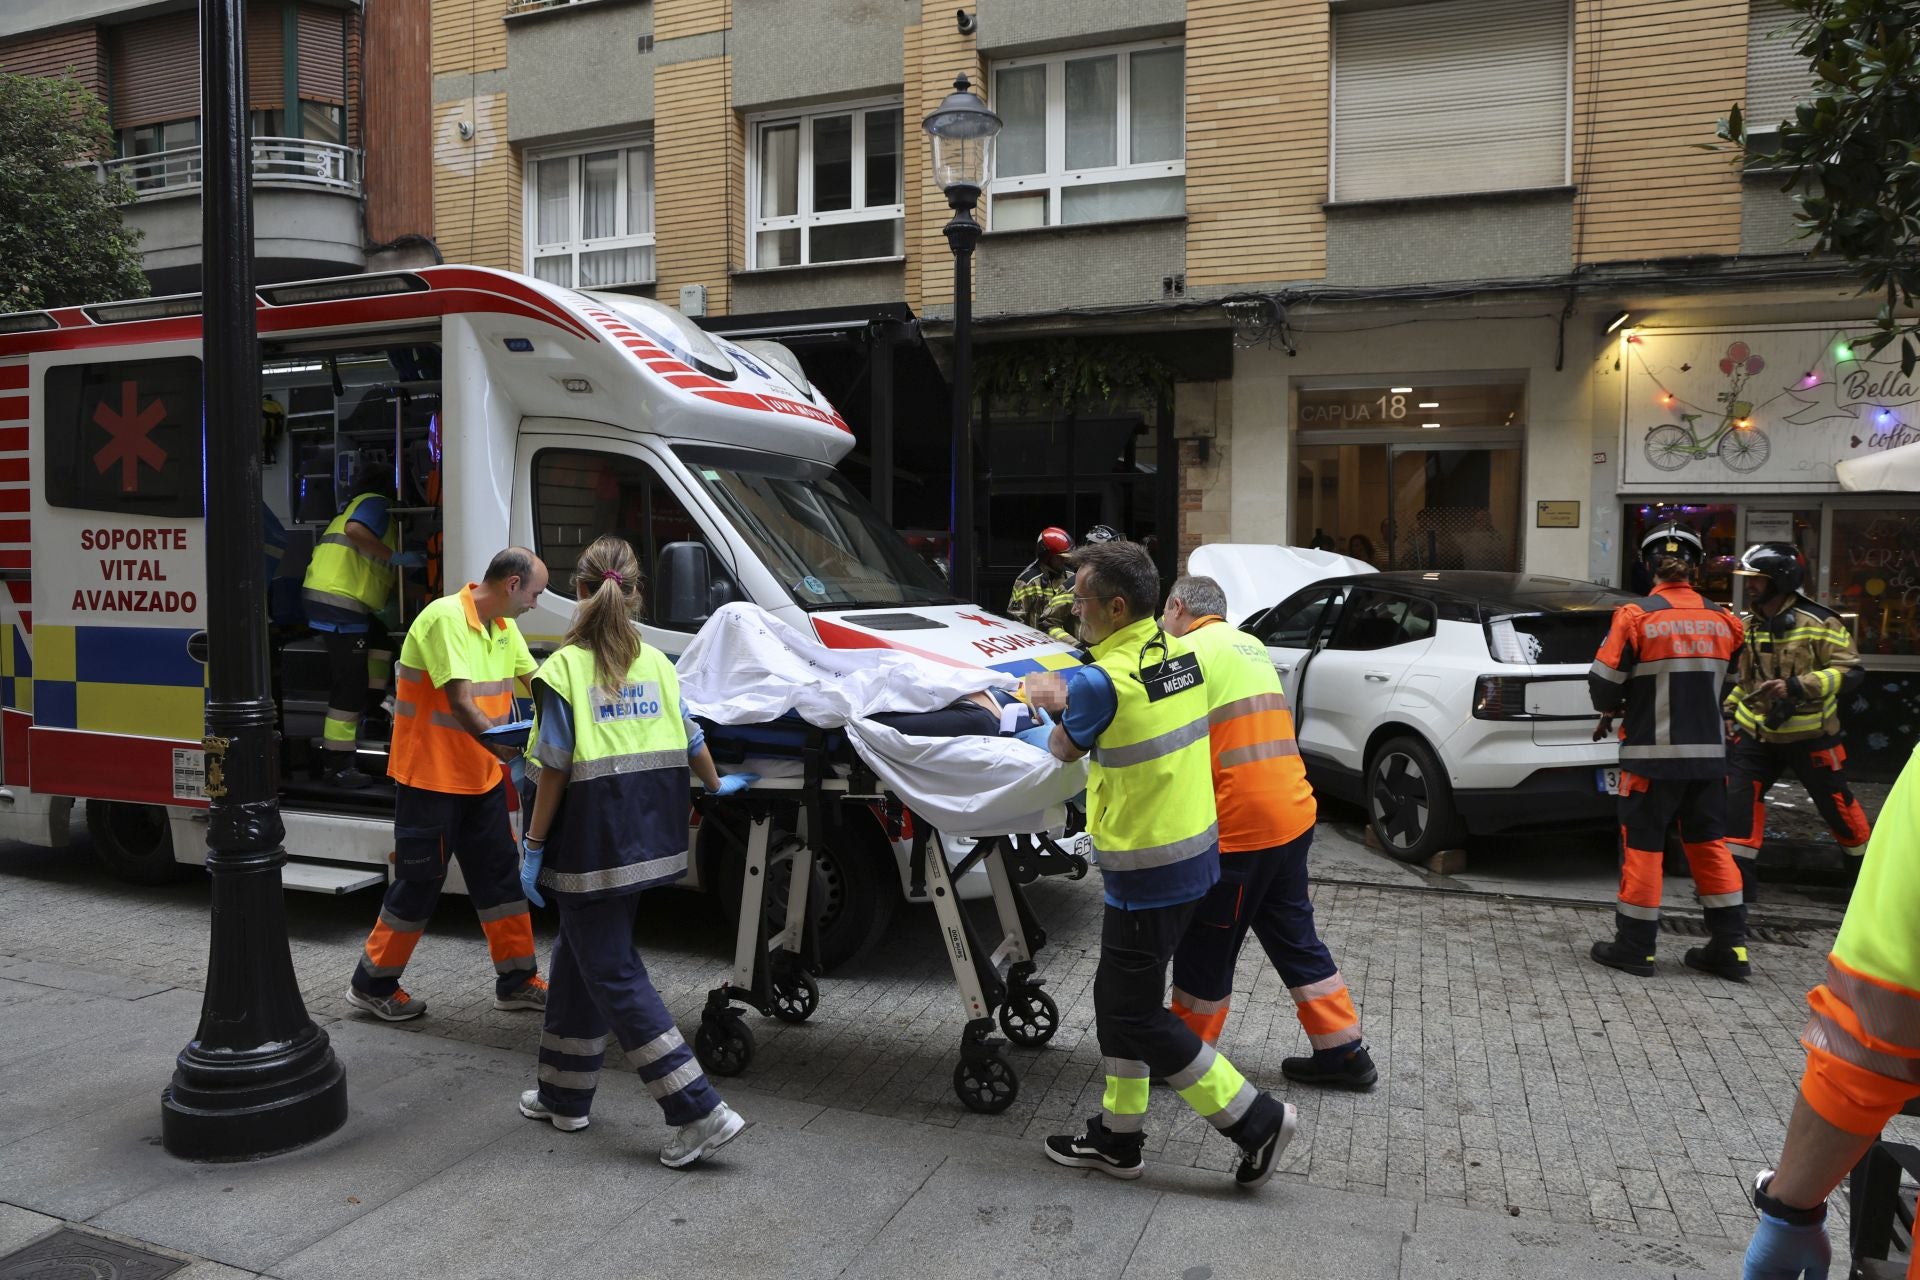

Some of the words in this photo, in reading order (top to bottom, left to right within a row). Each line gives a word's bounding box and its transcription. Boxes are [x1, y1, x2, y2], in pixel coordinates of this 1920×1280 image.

[1842, 369, 1919, 400] Bella
[769, 399, 796, 414] UVI
[1301, 404, 1370, 422] CAPUA
[1376, 395, 1407, 420] 18
[80, 528, 187, 551] SOPORTE
[99, 559, 167, 581] VITAL
[71, 589, 197, 613] AVANZADO
[1644, 619, 1732, 639] BOMBEROS
[1672, 638, 1714, 655] GIJÓN
[1163, 672, 1195, 694] MÉDICO
[1607, 771, 1617, 788] 3
[951, 929, 959, 942] 900
